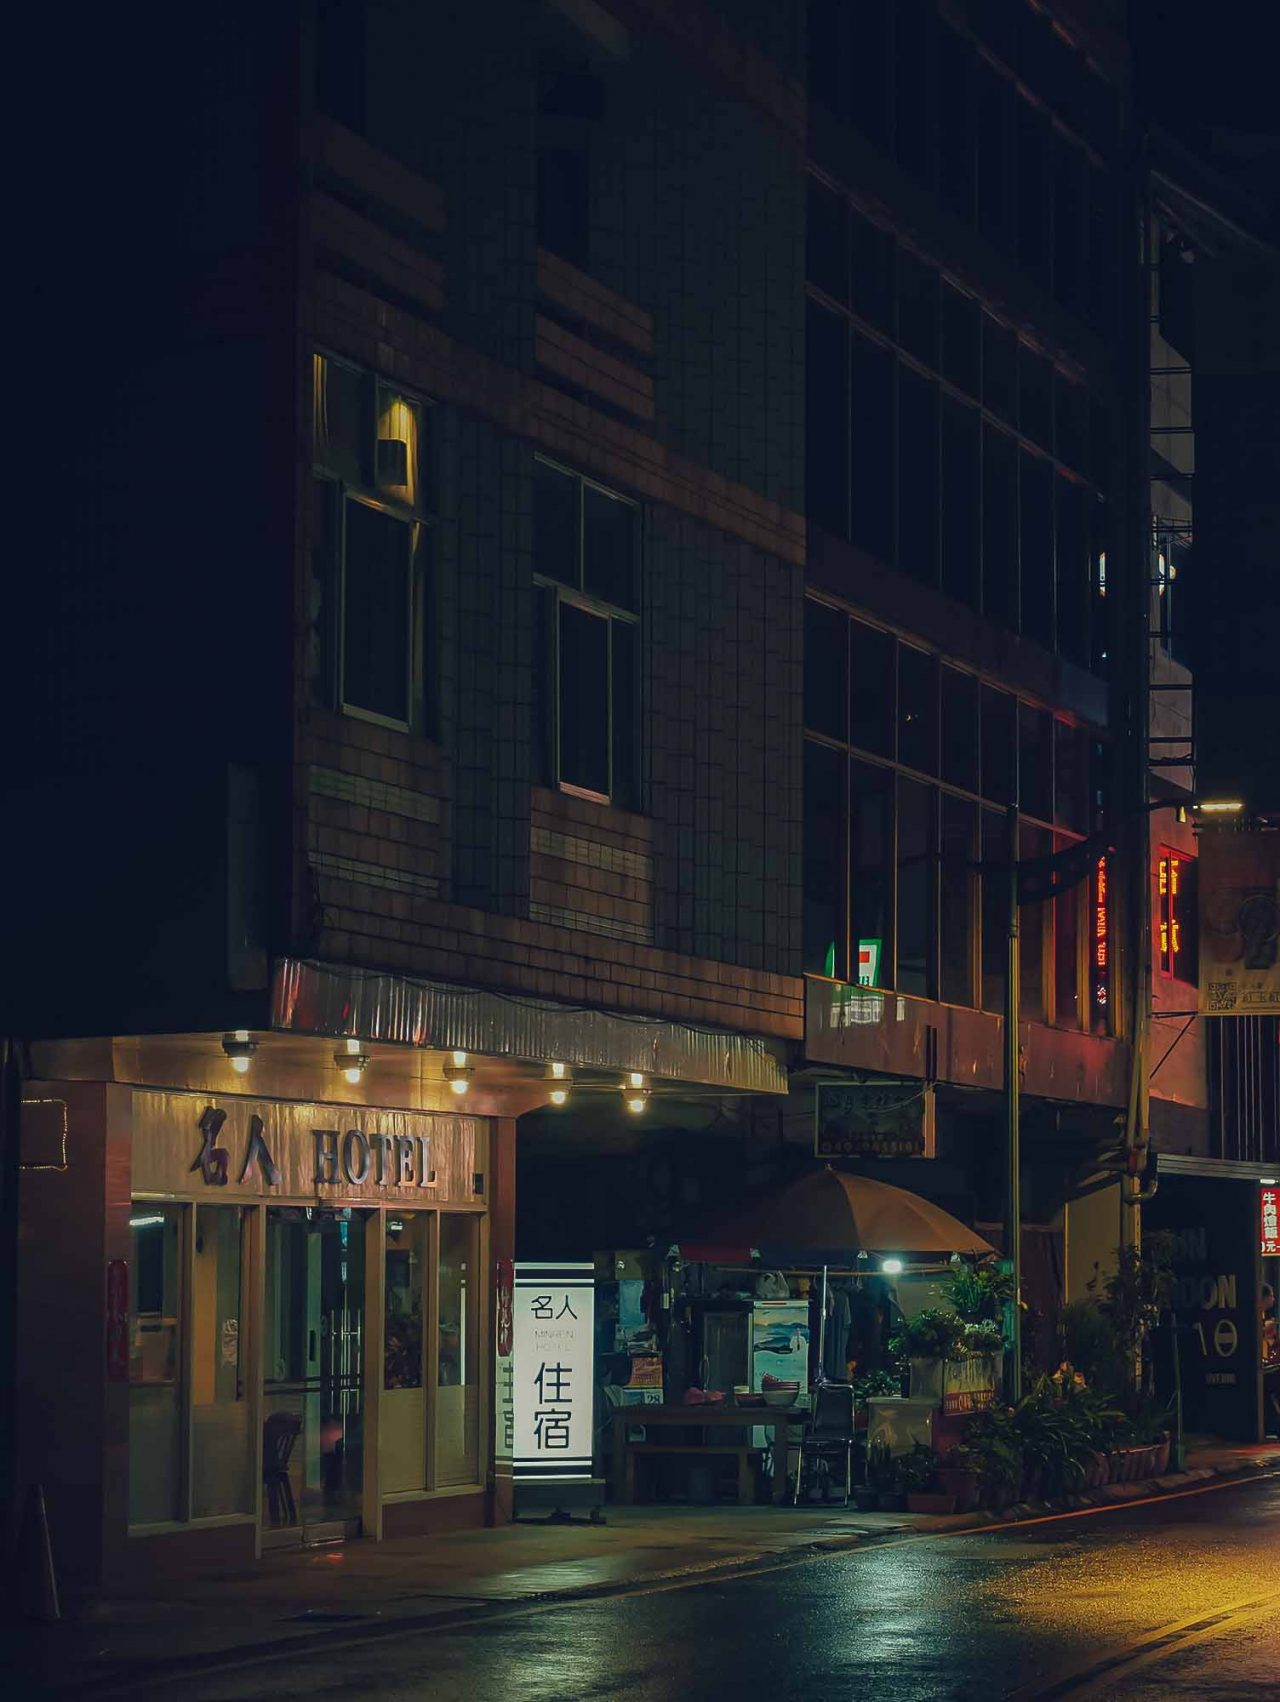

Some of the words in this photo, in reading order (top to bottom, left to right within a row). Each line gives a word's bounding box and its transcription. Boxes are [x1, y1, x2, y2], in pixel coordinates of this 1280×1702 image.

[190, 1105, 282, 1187] 名人
[311, 1128, 439, 1189] HOTEL
[531, 1294, 578, 1320] 名人
[533, 1361, 573, 1450] 住宿
